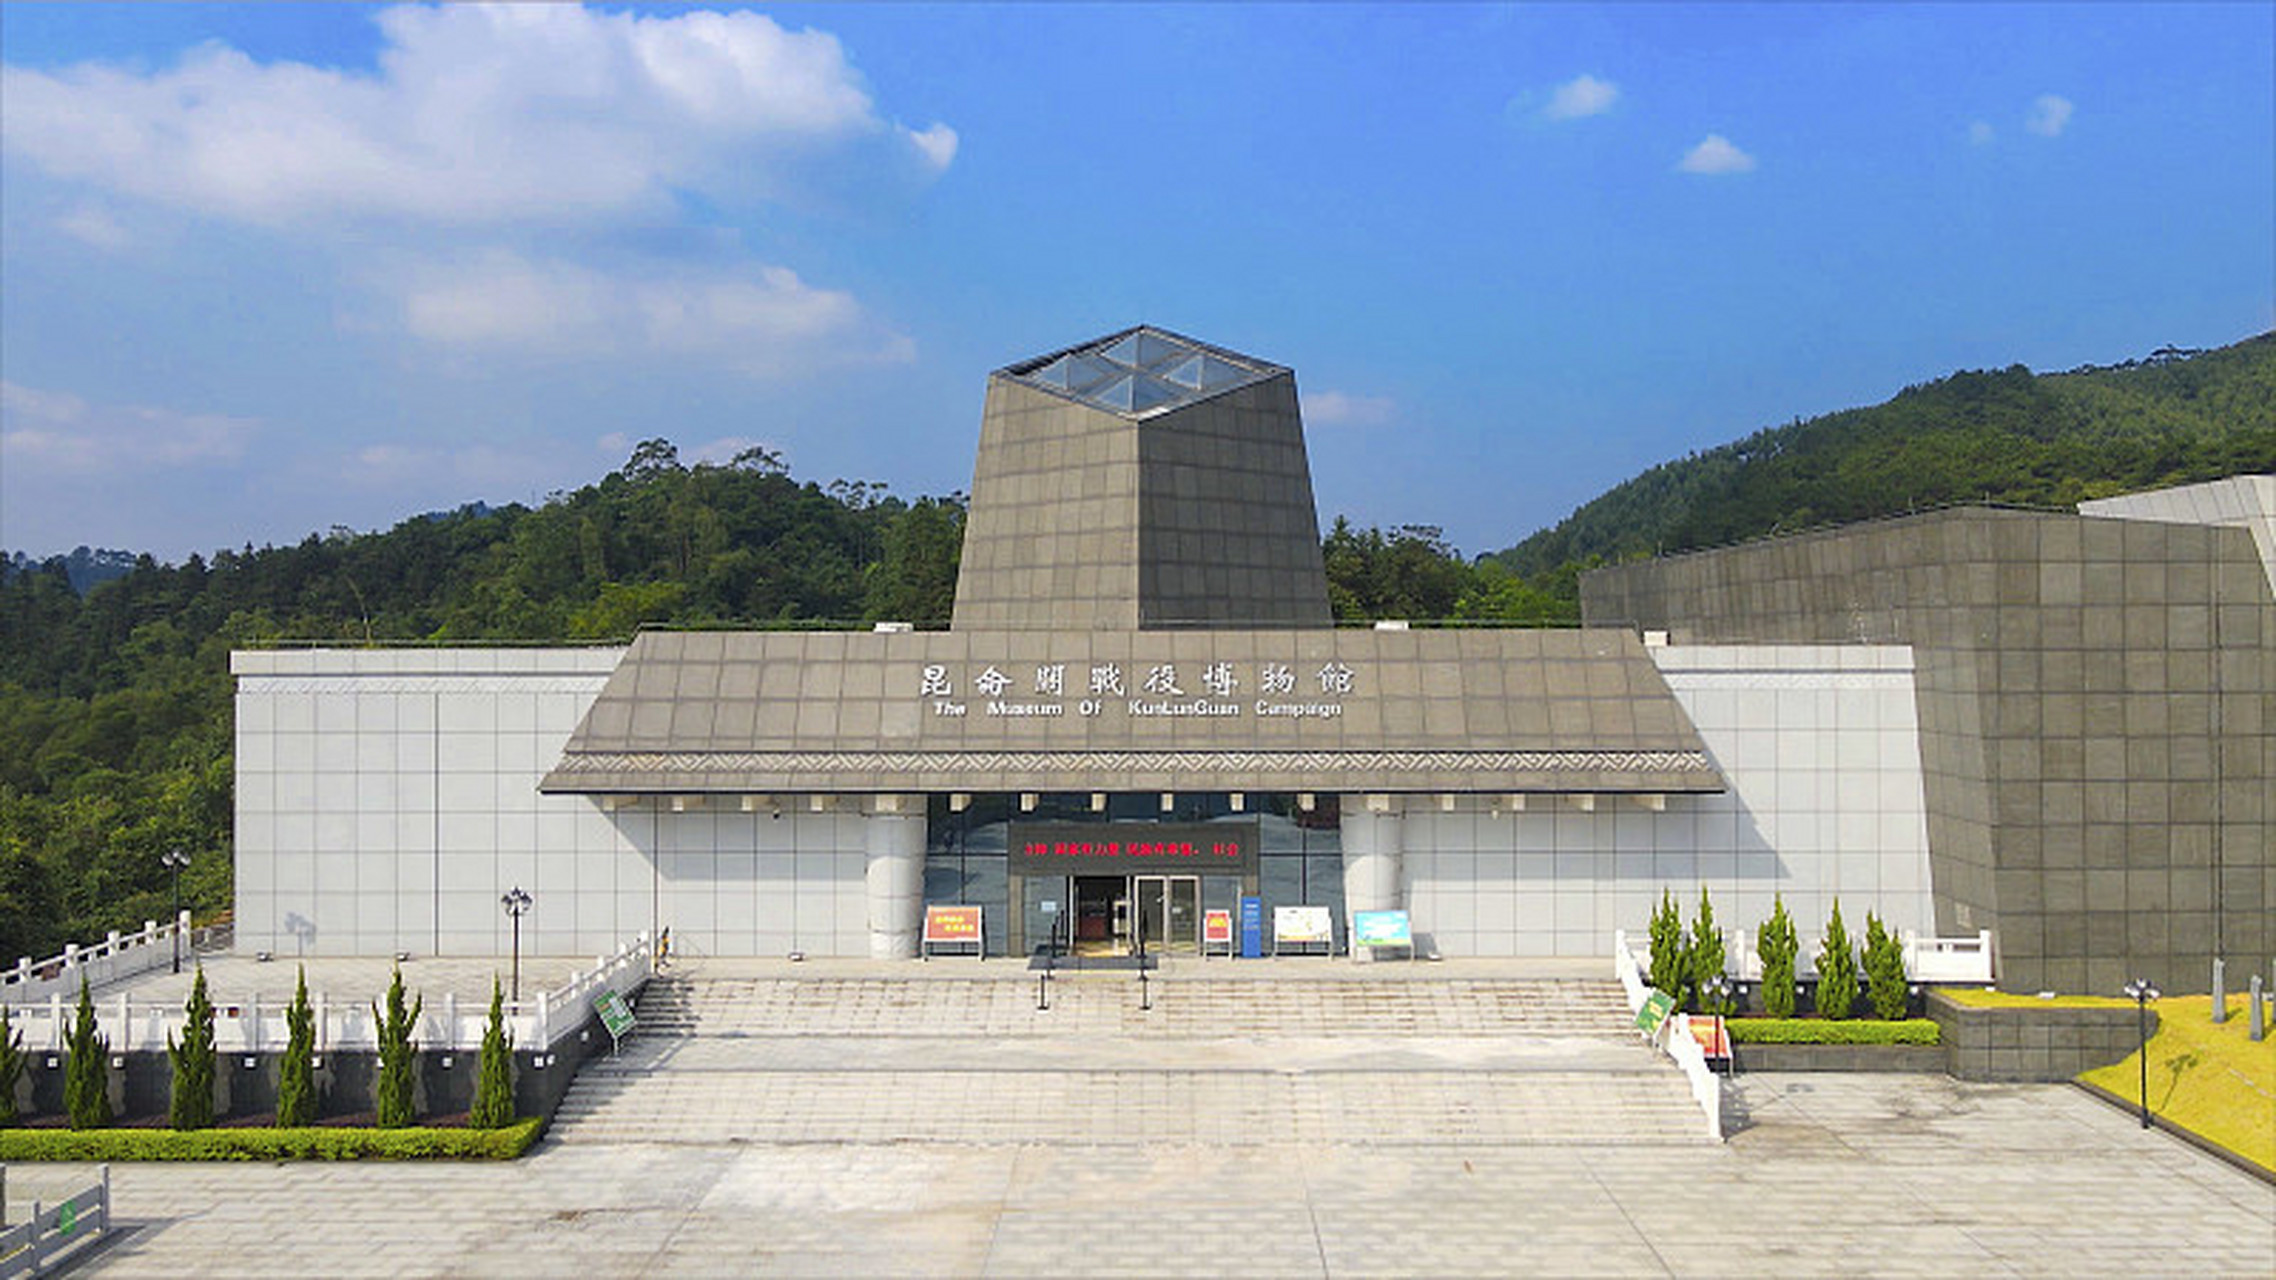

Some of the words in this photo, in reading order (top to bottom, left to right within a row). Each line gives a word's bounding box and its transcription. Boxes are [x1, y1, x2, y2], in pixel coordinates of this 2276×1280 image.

[934, 701, 966, 716] The
[987, 701, 1063, 716] Museum
[1079, 699, 1102, 716] Of
[1255, 699, 1342, 718] Campaign
